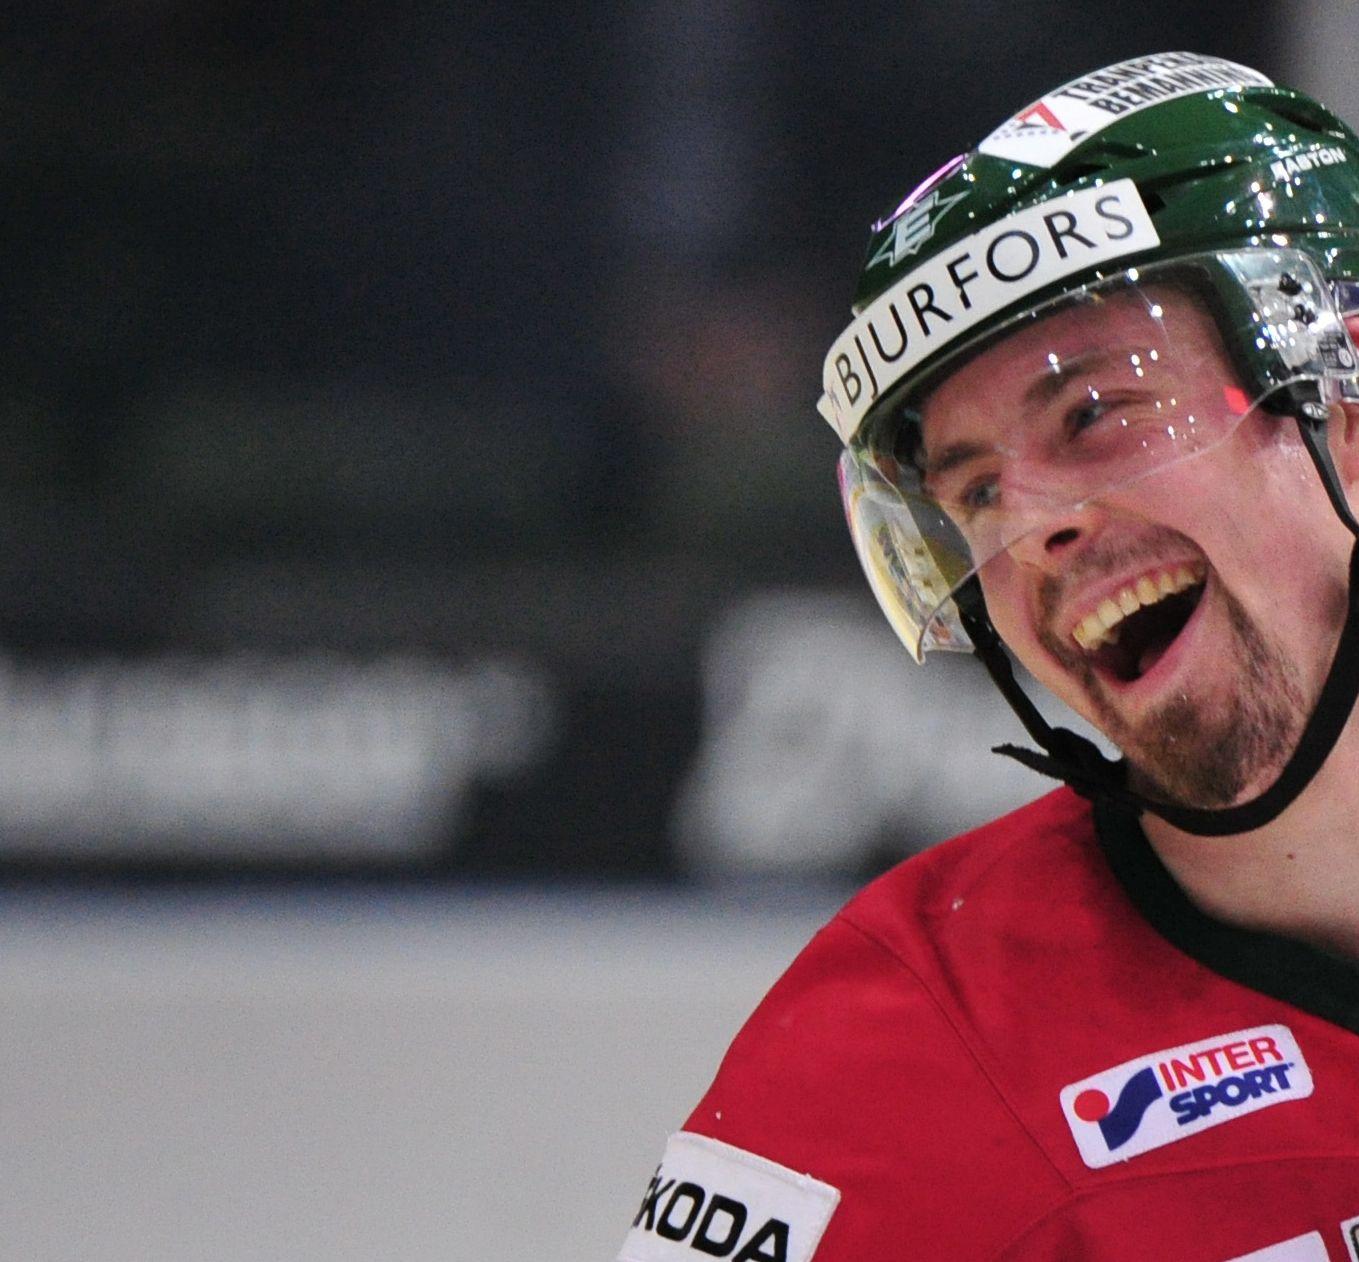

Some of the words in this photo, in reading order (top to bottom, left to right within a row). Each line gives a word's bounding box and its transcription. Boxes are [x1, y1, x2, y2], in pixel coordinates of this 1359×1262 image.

[834, 194, 1135, 408] BJURFORS
[1158, 1037, 1284, 1092] INTER
[1169, 1063, 1291, 1126] SPORT
[632, 1164, 791, 1262] KODA
